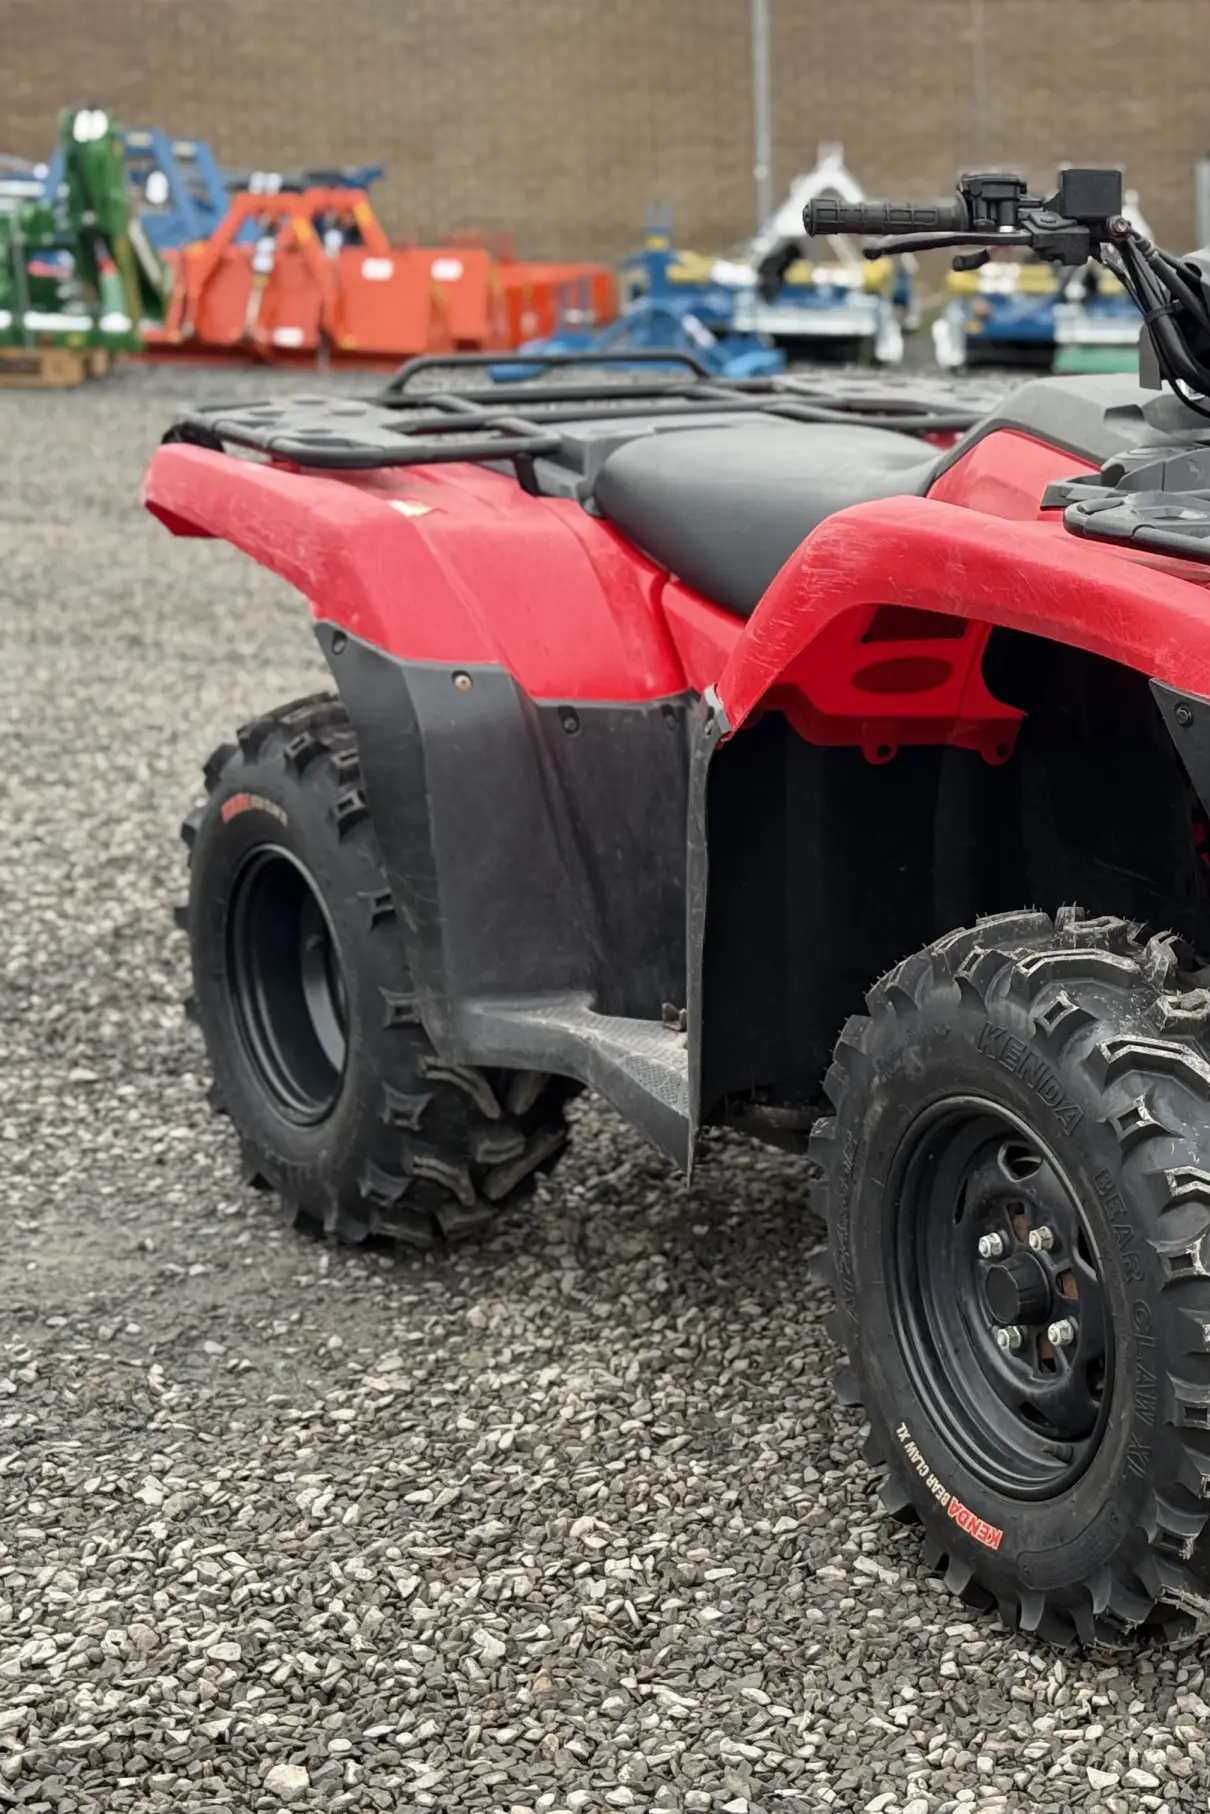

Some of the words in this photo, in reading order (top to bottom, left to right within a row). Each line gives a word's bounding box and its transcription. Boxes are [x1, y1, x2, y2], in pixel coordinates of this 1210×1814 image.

[977, 1020, 1085, 1137] KENDA
[1092, 1168, 1146, 1284] BEAR
[1130, 1299, 1158, 1428] CLAW
[896, 1422, 911, 1442] XL
[1121, 1431, 1154, 1480] XL
[904, 1441, 930, 1477] CLAW
[925, 1474, 951, 1507] BEAR
[947, 1496, 1004, 1550] KENDA
